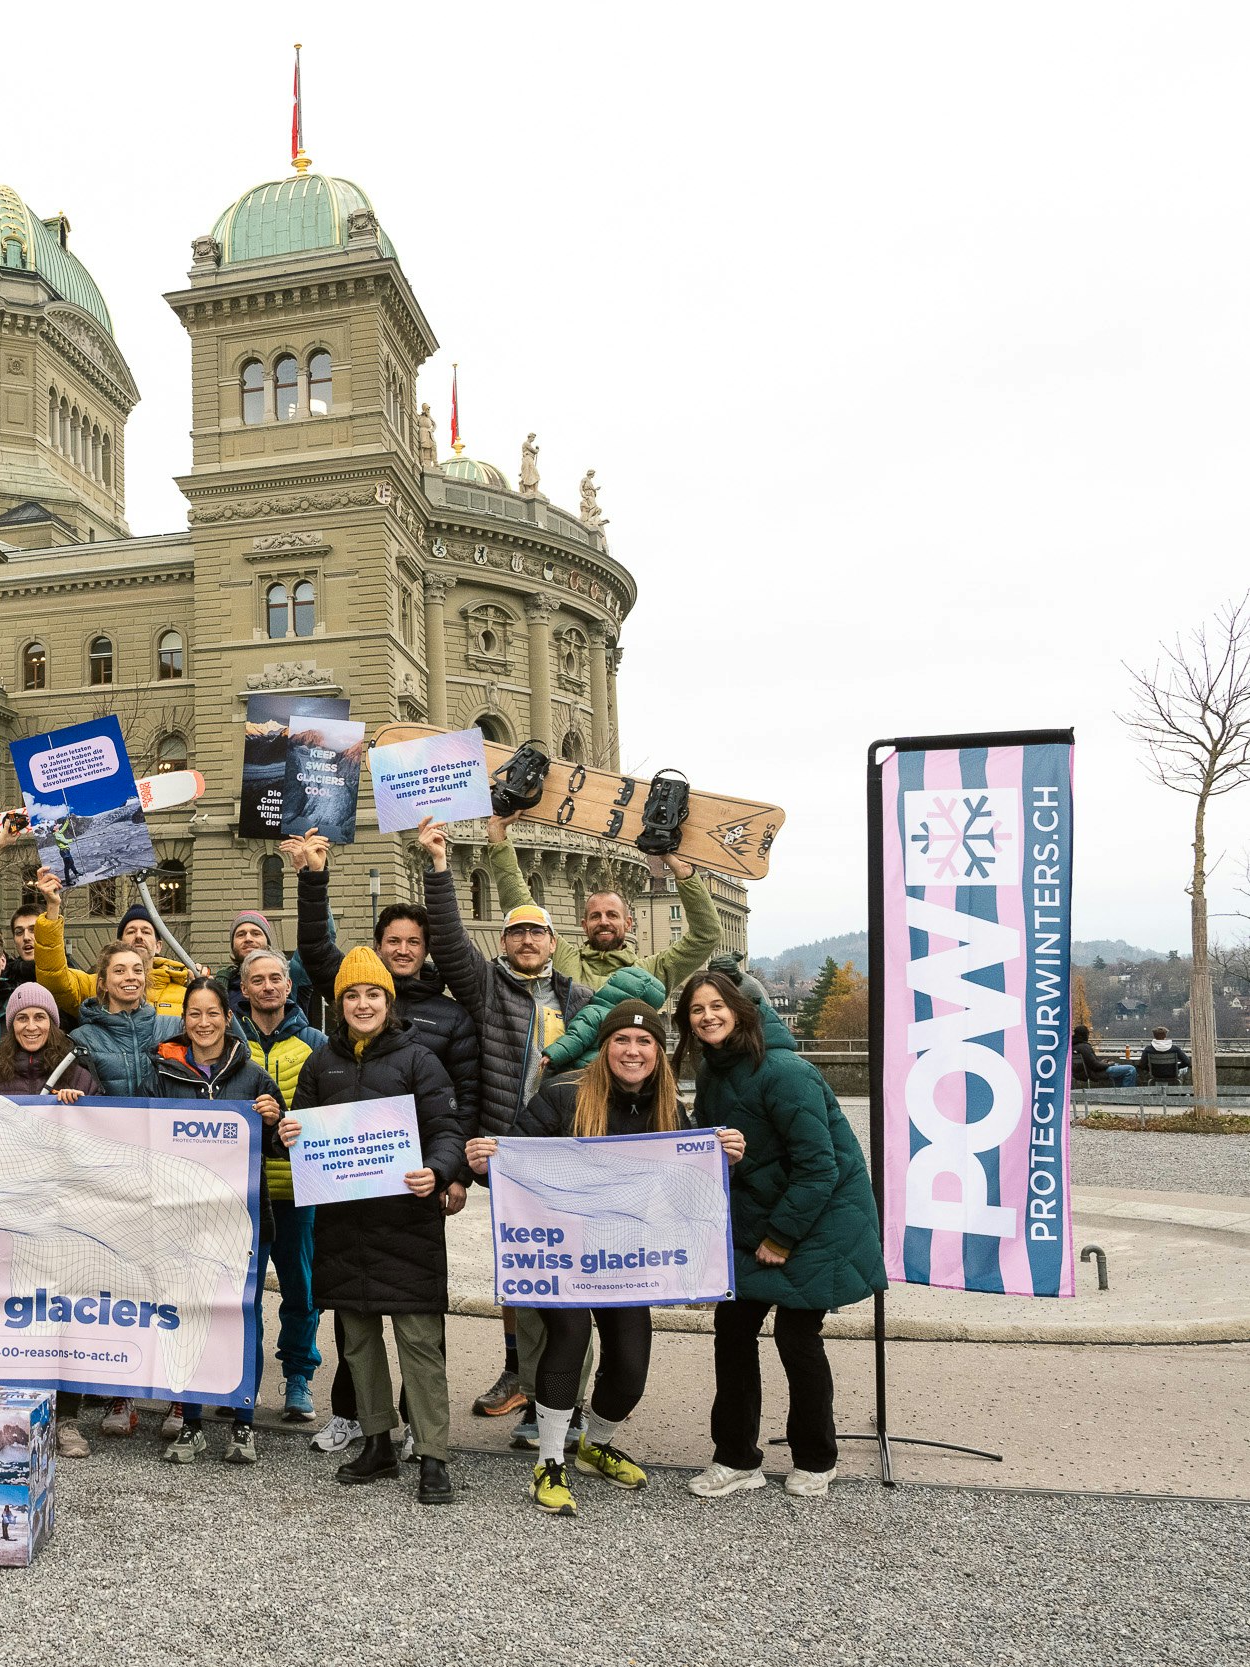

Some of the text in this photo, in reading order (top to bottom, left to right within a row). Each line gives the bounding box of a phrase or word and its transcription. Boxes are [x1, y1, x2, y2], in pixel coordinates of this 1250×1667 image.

[49, 757, 70, 767] Jahren
[71, 752, 92, 761] haben
[55, 751, 68, 759] den
[69, 745, 92, 755] letzten
[310, 749, 336, 760] KEEP
[41, 755, 105, 776] Schweizer Gletscher
[58, 766, 86, 777] VIERTEL
[87, 761, 104, 770] ihres
[305, 761, 338, 773] SWISS
[380, 760, 480, 783] Für unsere Gletscher,
[42, 766, 112, 788] Eisvolumens verloren.
[296, 772, 345, 786] GLACIERS
[390, 770, 472, 791] unsere Berge und
[305, 786, 333, 797] COOL
[396, 780, 468, 799] unsere Zukunft
[257, 804, 280, 812] einen
[429, 796, 452, 804] handeln
[756, 823, 776, 861] Joes
[1030, 786, 1058, 1241] PROTECTOURWINTERS.CH
[905, 895, 1024, 1238] POW
[173, 1121, 222, 1138] POW
[303, 1129, 409, 1149] Pour nos glaciers,
[676, 1141, 705, 1152] POW
[305, 1140, 410, 1162] nos montagnes et
[322, 1154, 395, 1171] notre avenir
[349, 1169, 384, 1178] maintenant
[500, 1223, 565, 1247] keep
[501, 1248, 688, 1274] swiss glaciers
[502, 1275, 559, 1295] cool
[572, 1280, 660, 1290] 1400-reasons-to-act.ch
[4, 1287, 180, 1330] glaciers
